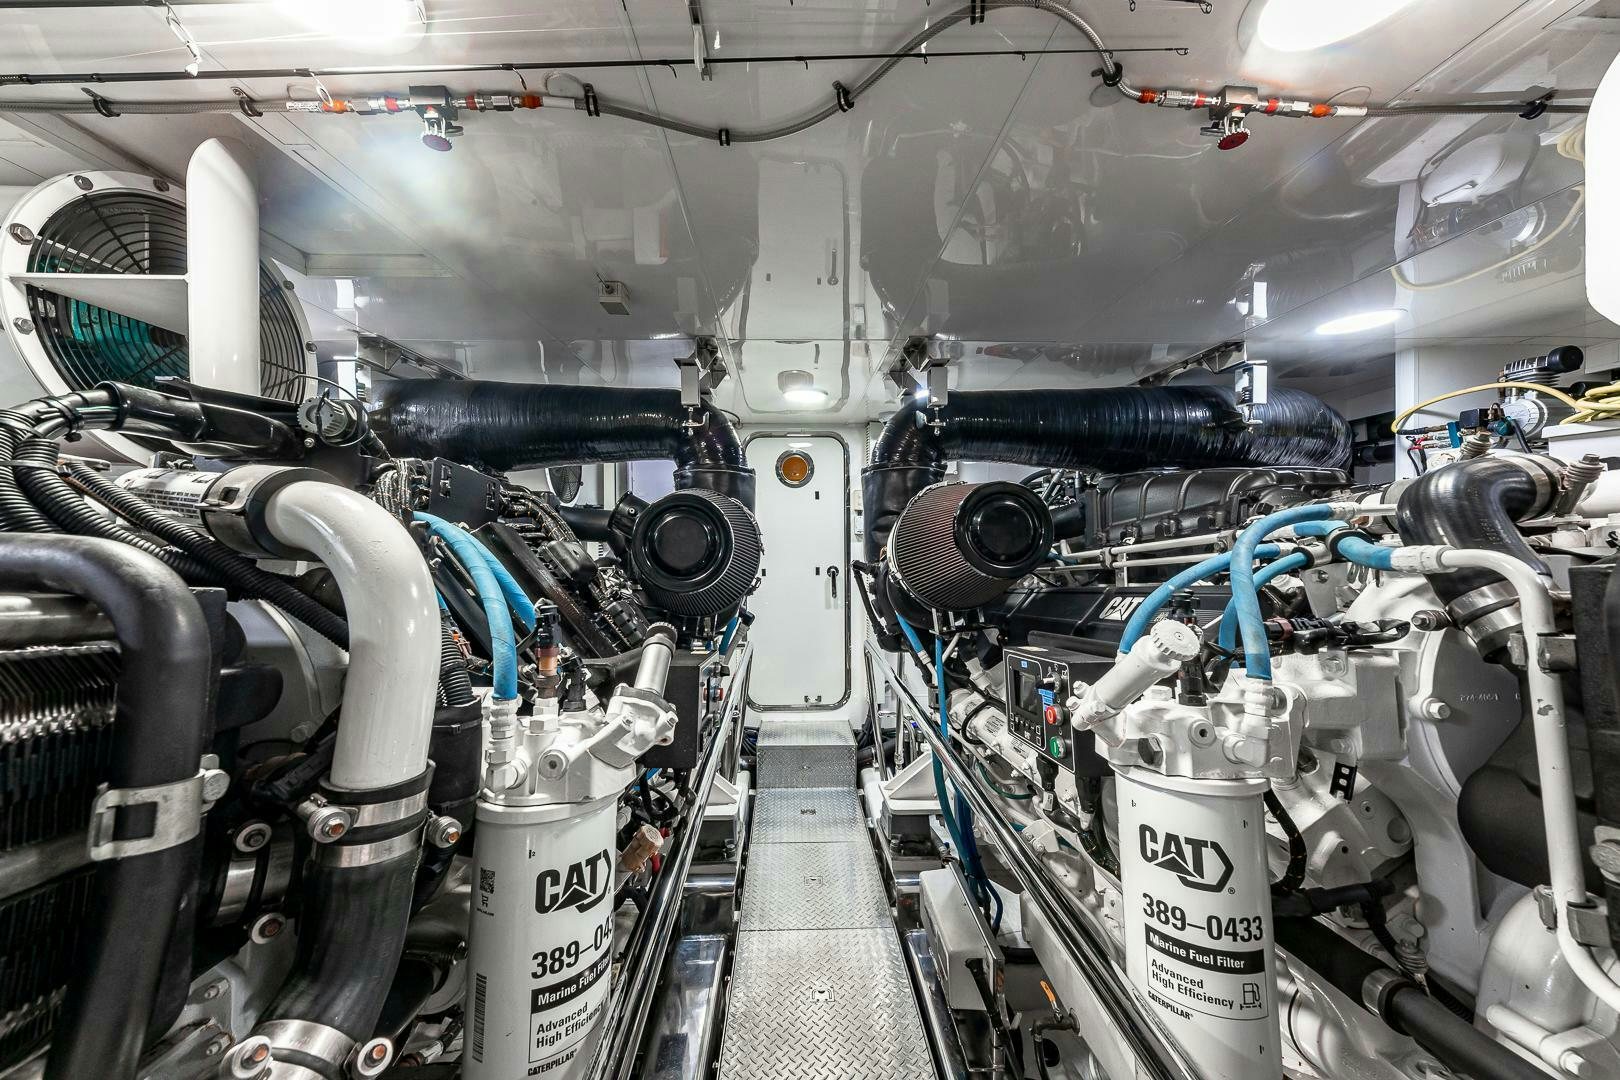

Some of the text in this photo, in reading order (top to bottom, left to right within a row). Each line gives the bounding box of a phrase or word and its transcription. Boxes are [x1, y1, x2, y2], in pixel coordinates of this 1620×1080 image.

[1099, 596, 1146, 621] CAT
[1139, 823, 1209, 880] CAT
[535, 851, 602, 914] CAT
[1142, 892, 1264, 943] 389-0433
[1149, 932, 1245, 969] Marine Fuel Filter
[537, 984, 577, 1006] Marine
[579, 970, 597, 989] Fuel
[1151, 958, 1204, 990] Advanced
[1152, 971, 1235, 1010] High Efficiency
[536, 1002, 588, 1035] Advanced
[536, 1003, 603, 1049] High Efficienc
